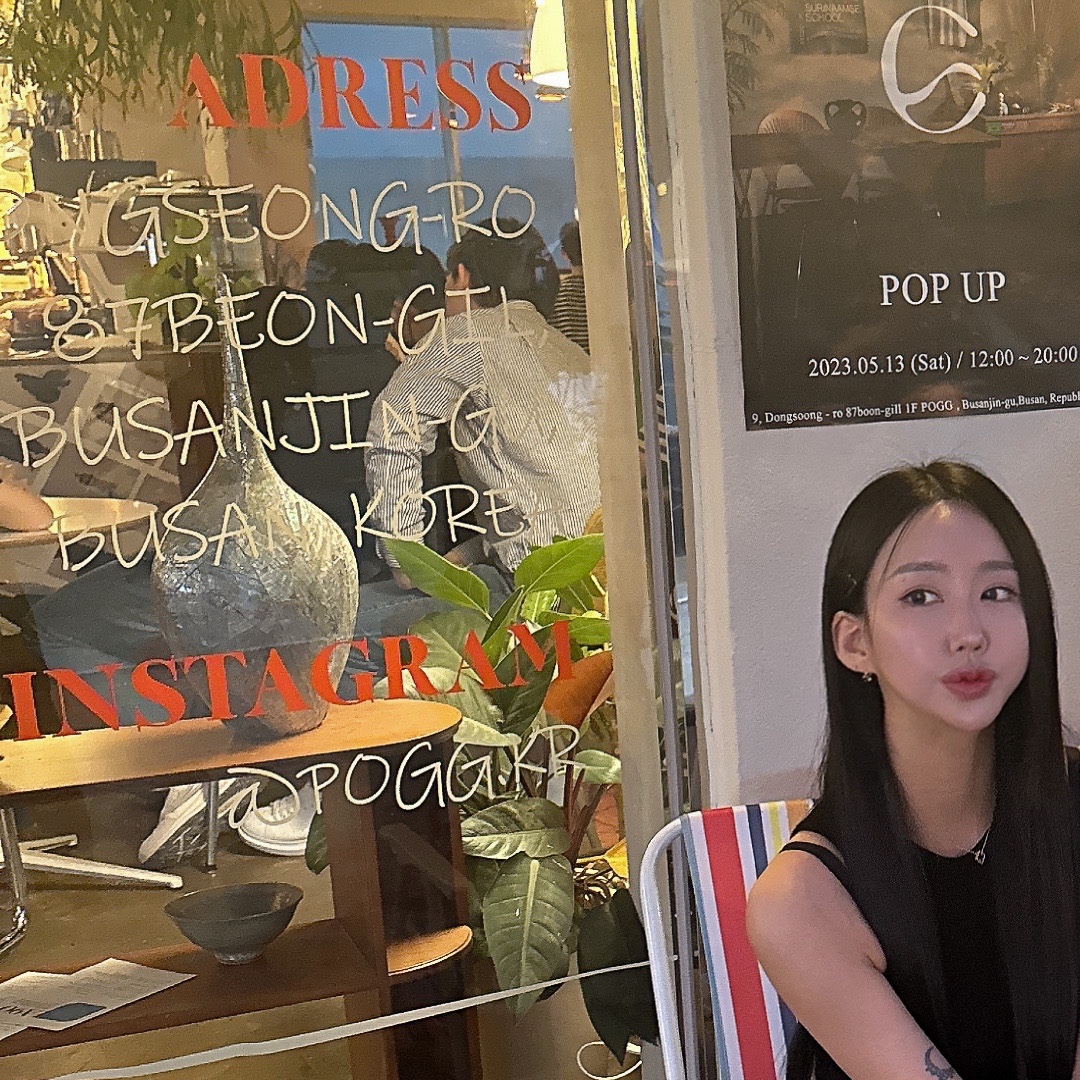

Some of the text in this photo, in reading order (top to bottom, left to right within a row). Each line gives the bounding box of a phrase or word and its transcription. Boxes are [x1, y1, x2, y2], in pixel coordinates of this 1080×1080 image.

[167, 52, 533, 132] ADRESS
[879, 271, 1006, 306] POP UP
[808, 354, 905, 378] 2023.05.13
[910, 352, 952, 376] (Sat)
[956, 351, 964, 370] /
[969, 349, 1014, 369] 12:00
[1033, 345, 1078, 365] 20:00
[751, 412, 762, 425] 9,
[832, 409, 844, 419] ro
[905, 401, 918, 414] 1F
[920, 399, 954, 414] POGG
[2, 620, 575, 742] INSTAGRAM
